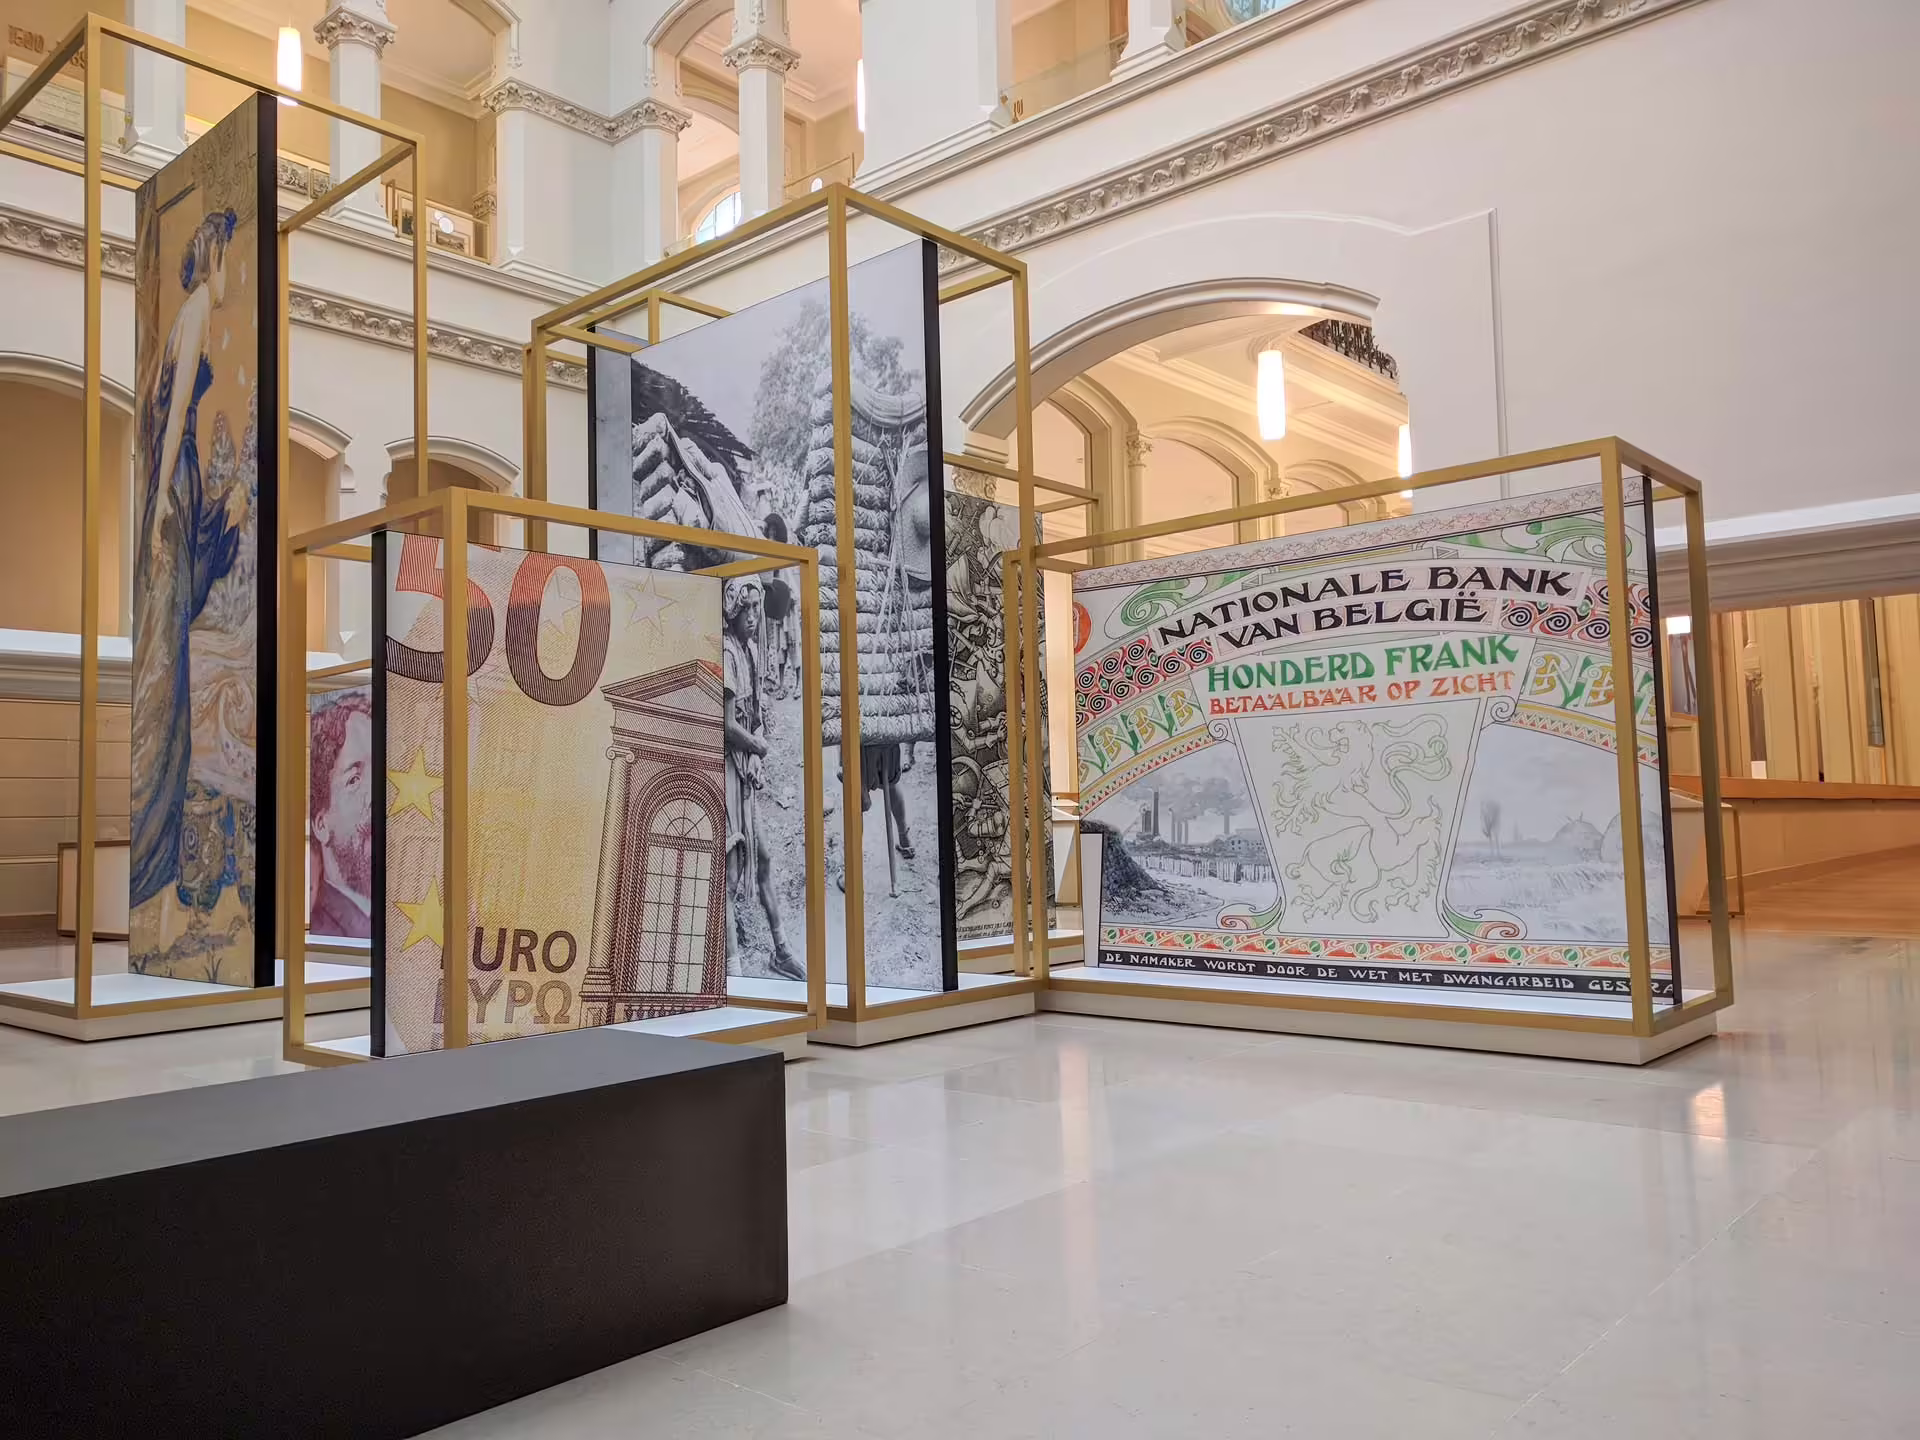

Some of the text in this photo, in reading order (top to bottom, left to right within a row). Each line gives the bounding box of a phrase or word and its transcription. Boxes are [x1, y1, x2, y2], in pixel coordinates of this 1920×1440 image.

[1158, 566, 1573, 646] NATIONALE BANK
[1219, 591, 1488, 648] VAN BELGIË
[1207, 633, 1519, 692] HONDERD FRANK
[1387, 680, 1421, 701] OP
[1429, 671, 1516, 698] ZICHT
[440, 926, 577, 974] URO
[1105, 952, 1674, 994] DE NAMAKER WORDT DOOR DE WET MET DWANGARBEID GESRA
